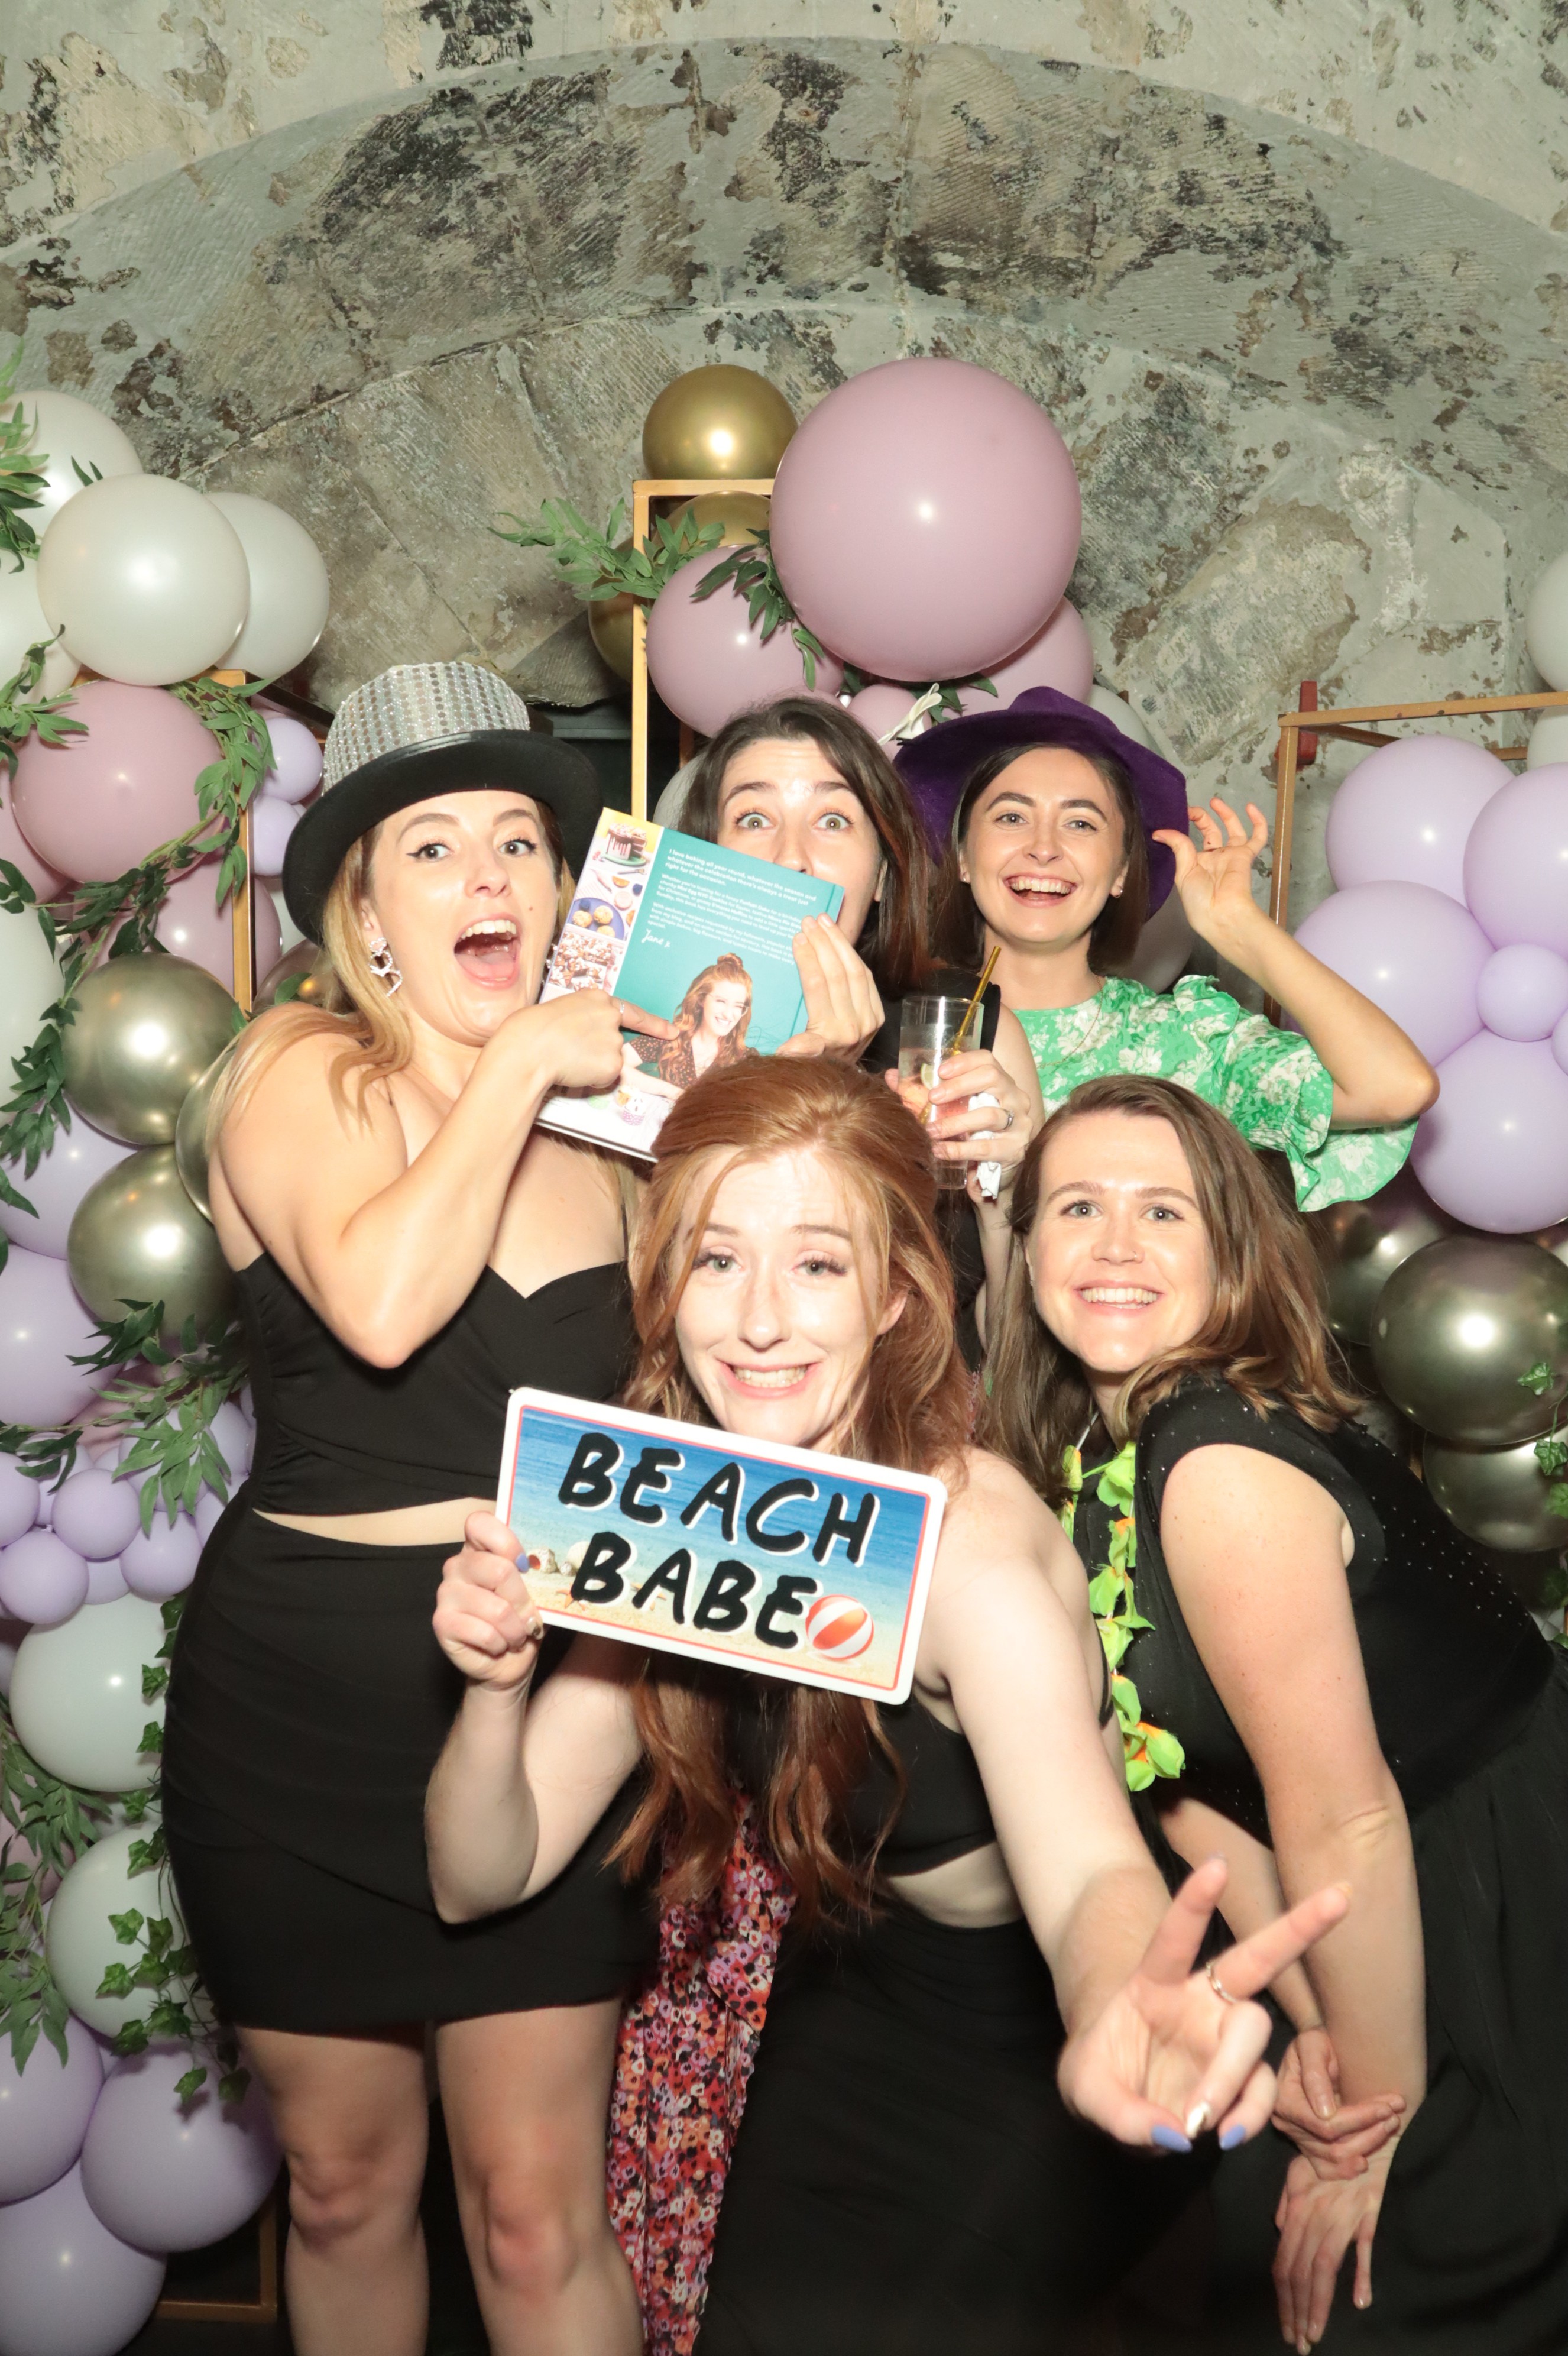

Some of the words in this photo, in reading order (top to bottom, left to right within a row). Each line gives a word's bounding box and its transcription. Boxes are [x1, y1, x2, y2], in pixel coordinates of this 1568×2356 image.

[667, 856, 694, 867] whatever
[705, 869, 737, 882] celebration
[737, 879, 757, 888] there's
[757, 886, 777, 895] always
[672, 849, 685, 857] love
[685, 854, 705, 866] baking
[728, 869, 746, 878] round,
[747, 875, 773, 886] whatever
[784, 888, 804, 897] season
[699, 874, 726, 885] occasion.
[641, 928, 664, 945] Jane
[558, 1432, 877, 1565] BEACH
[570, 1532, 819, 1649] BABE
